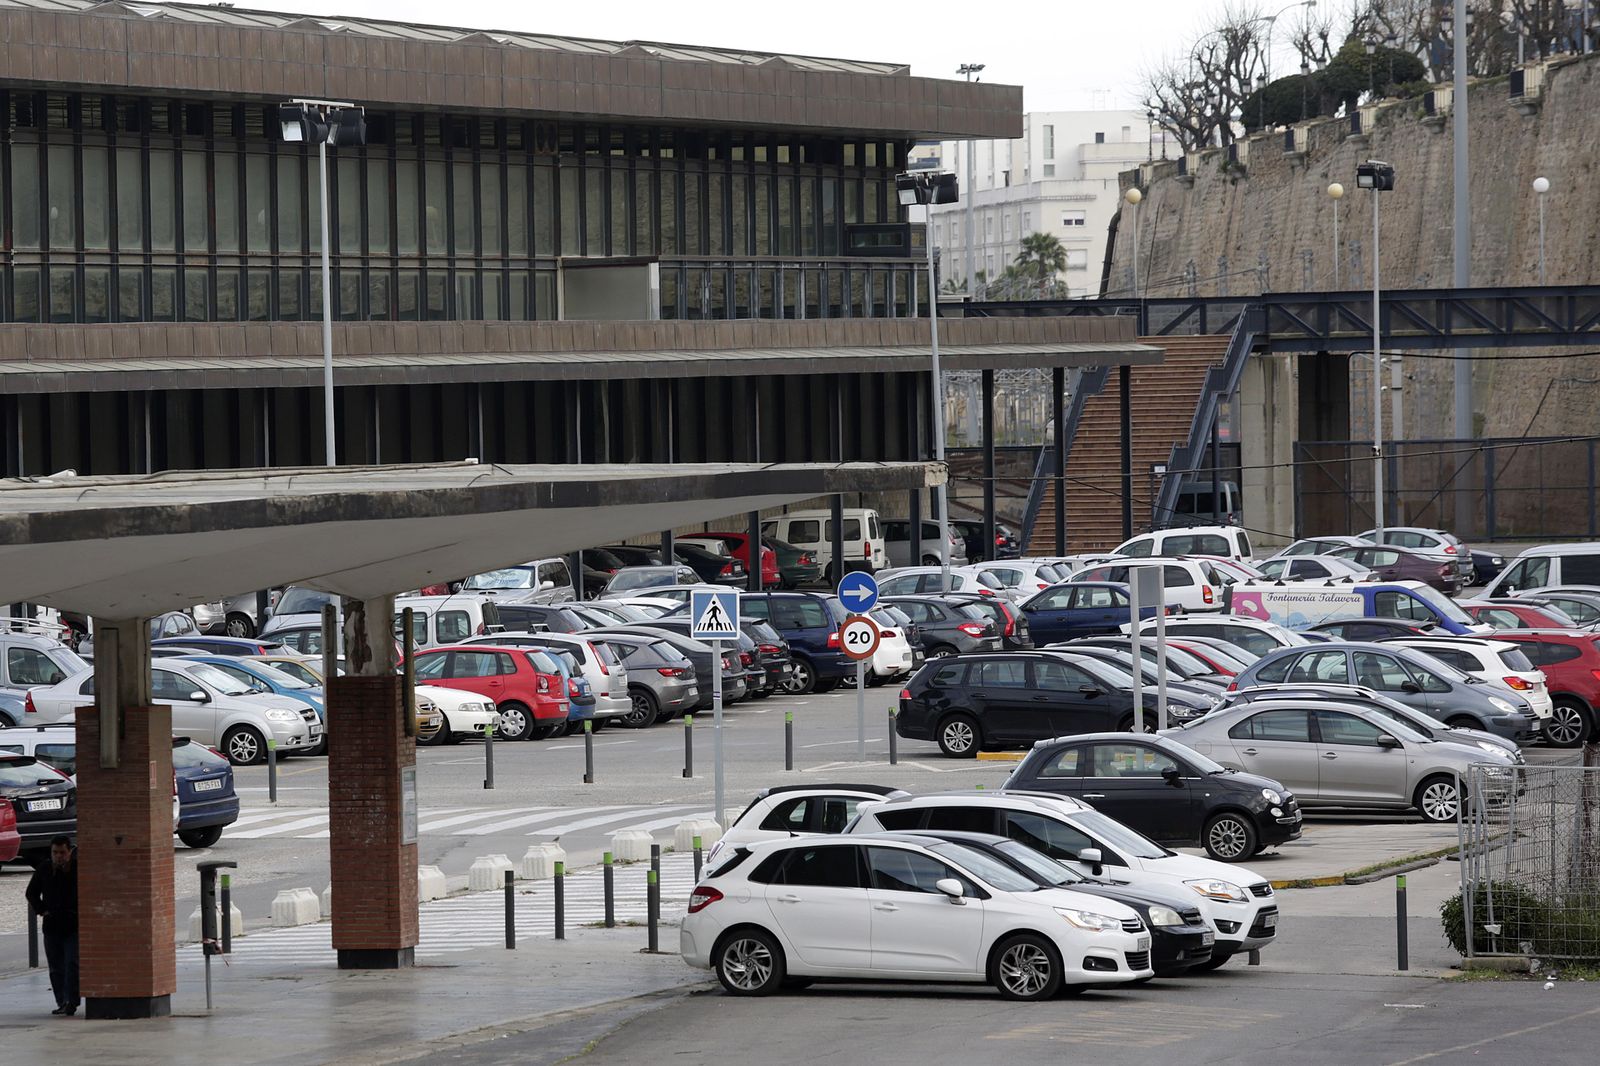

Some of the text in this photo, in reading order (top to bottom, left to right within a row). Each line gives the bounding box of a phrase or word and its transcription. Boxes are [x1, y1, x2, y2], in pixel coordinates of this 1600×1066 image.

[1267, 592, 1361, 603] Fontanería Talavera
[848, 631, 870, 644] 20
